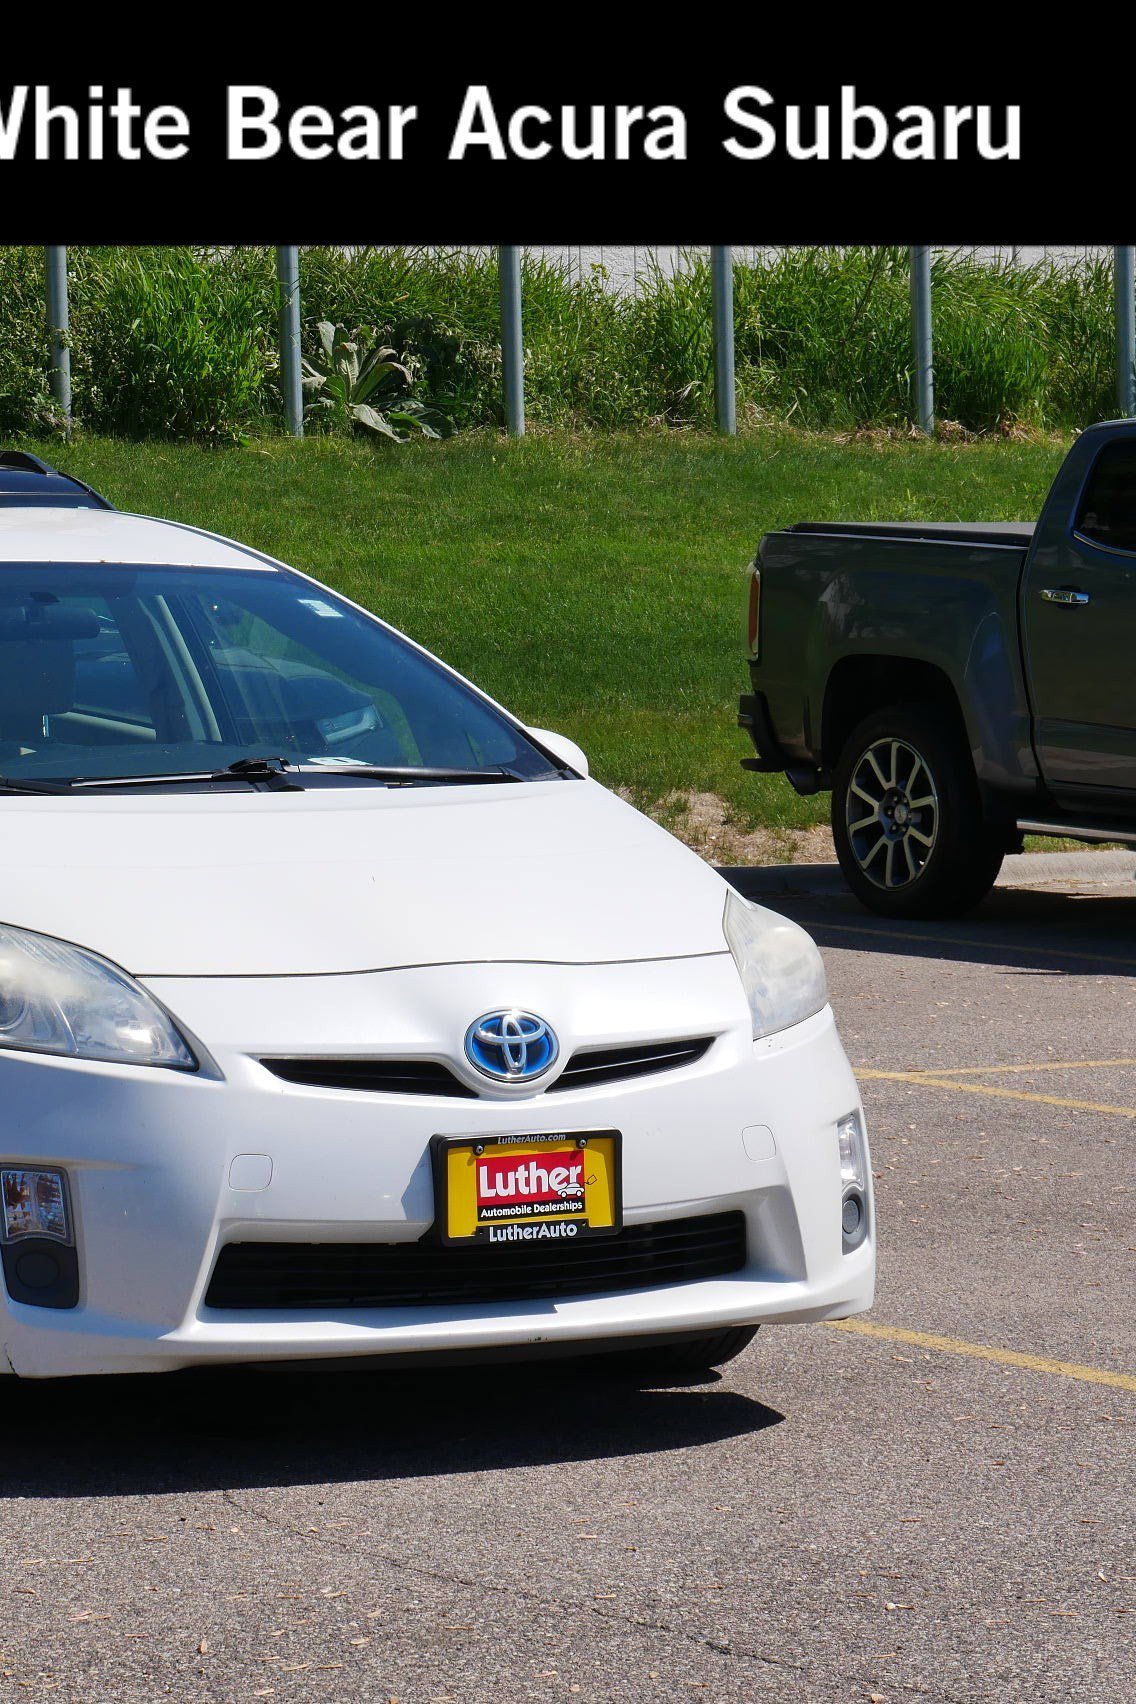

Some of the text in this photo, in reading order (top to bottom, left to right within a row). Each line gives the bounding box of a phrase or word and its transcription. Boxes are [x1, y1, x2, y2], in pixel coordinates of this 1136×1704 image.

[497, 1133, 566, 1145] LutherAuto.com
[479, 1161, 582, 1198] Luther
[480, 1200, 583, 1218] Automobile Dealerships
[489, 1223, 578, 1243] LutherAuto
